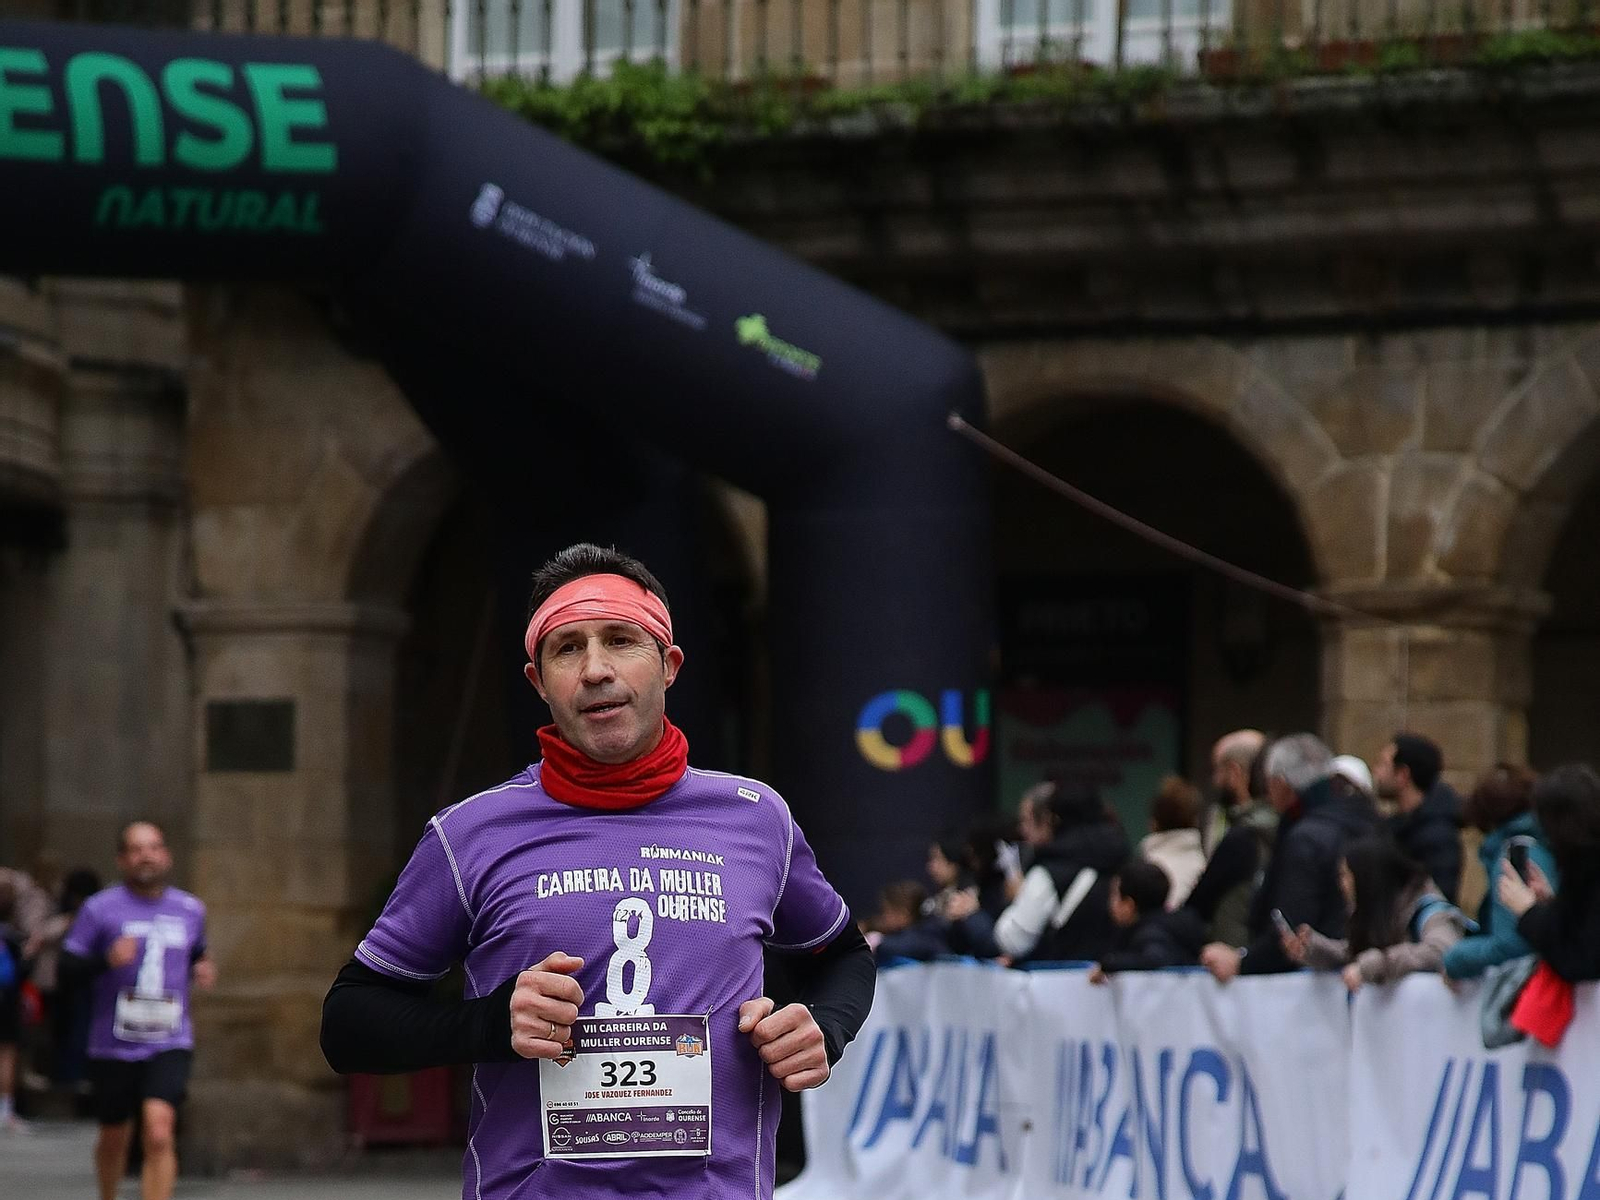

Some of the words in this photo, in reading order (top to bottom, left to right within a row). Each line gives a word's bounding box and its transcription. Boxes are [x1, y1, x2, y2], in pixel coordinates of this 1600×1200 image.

[94, 186, 324, 232] NATURAL
[537, 868, 625, 898] CARREIRA
[629, 867, 654, 893] DA
[659, 869, 723, 896] MULLER
[657, 895, 727, 923] OURENSE
[583, 1024, 597, 1033] VII
[600, 1022, 650, 1032] CARREIRA
[652, 1022, 668, 1031] DA
[580, 1038, 621, 1048] MULLER
[623, 1036, 671, 1046] OURENSE
[600, 1060, 657, 1087] 323
[584, 1091, 600, 1099] JOSE
[601, 1090, 632, 1099] VAZQUEZ
[633, 1088, 673, 1097] FERNANDEZ
[606, 1133, 628, 1142] ABRIL
